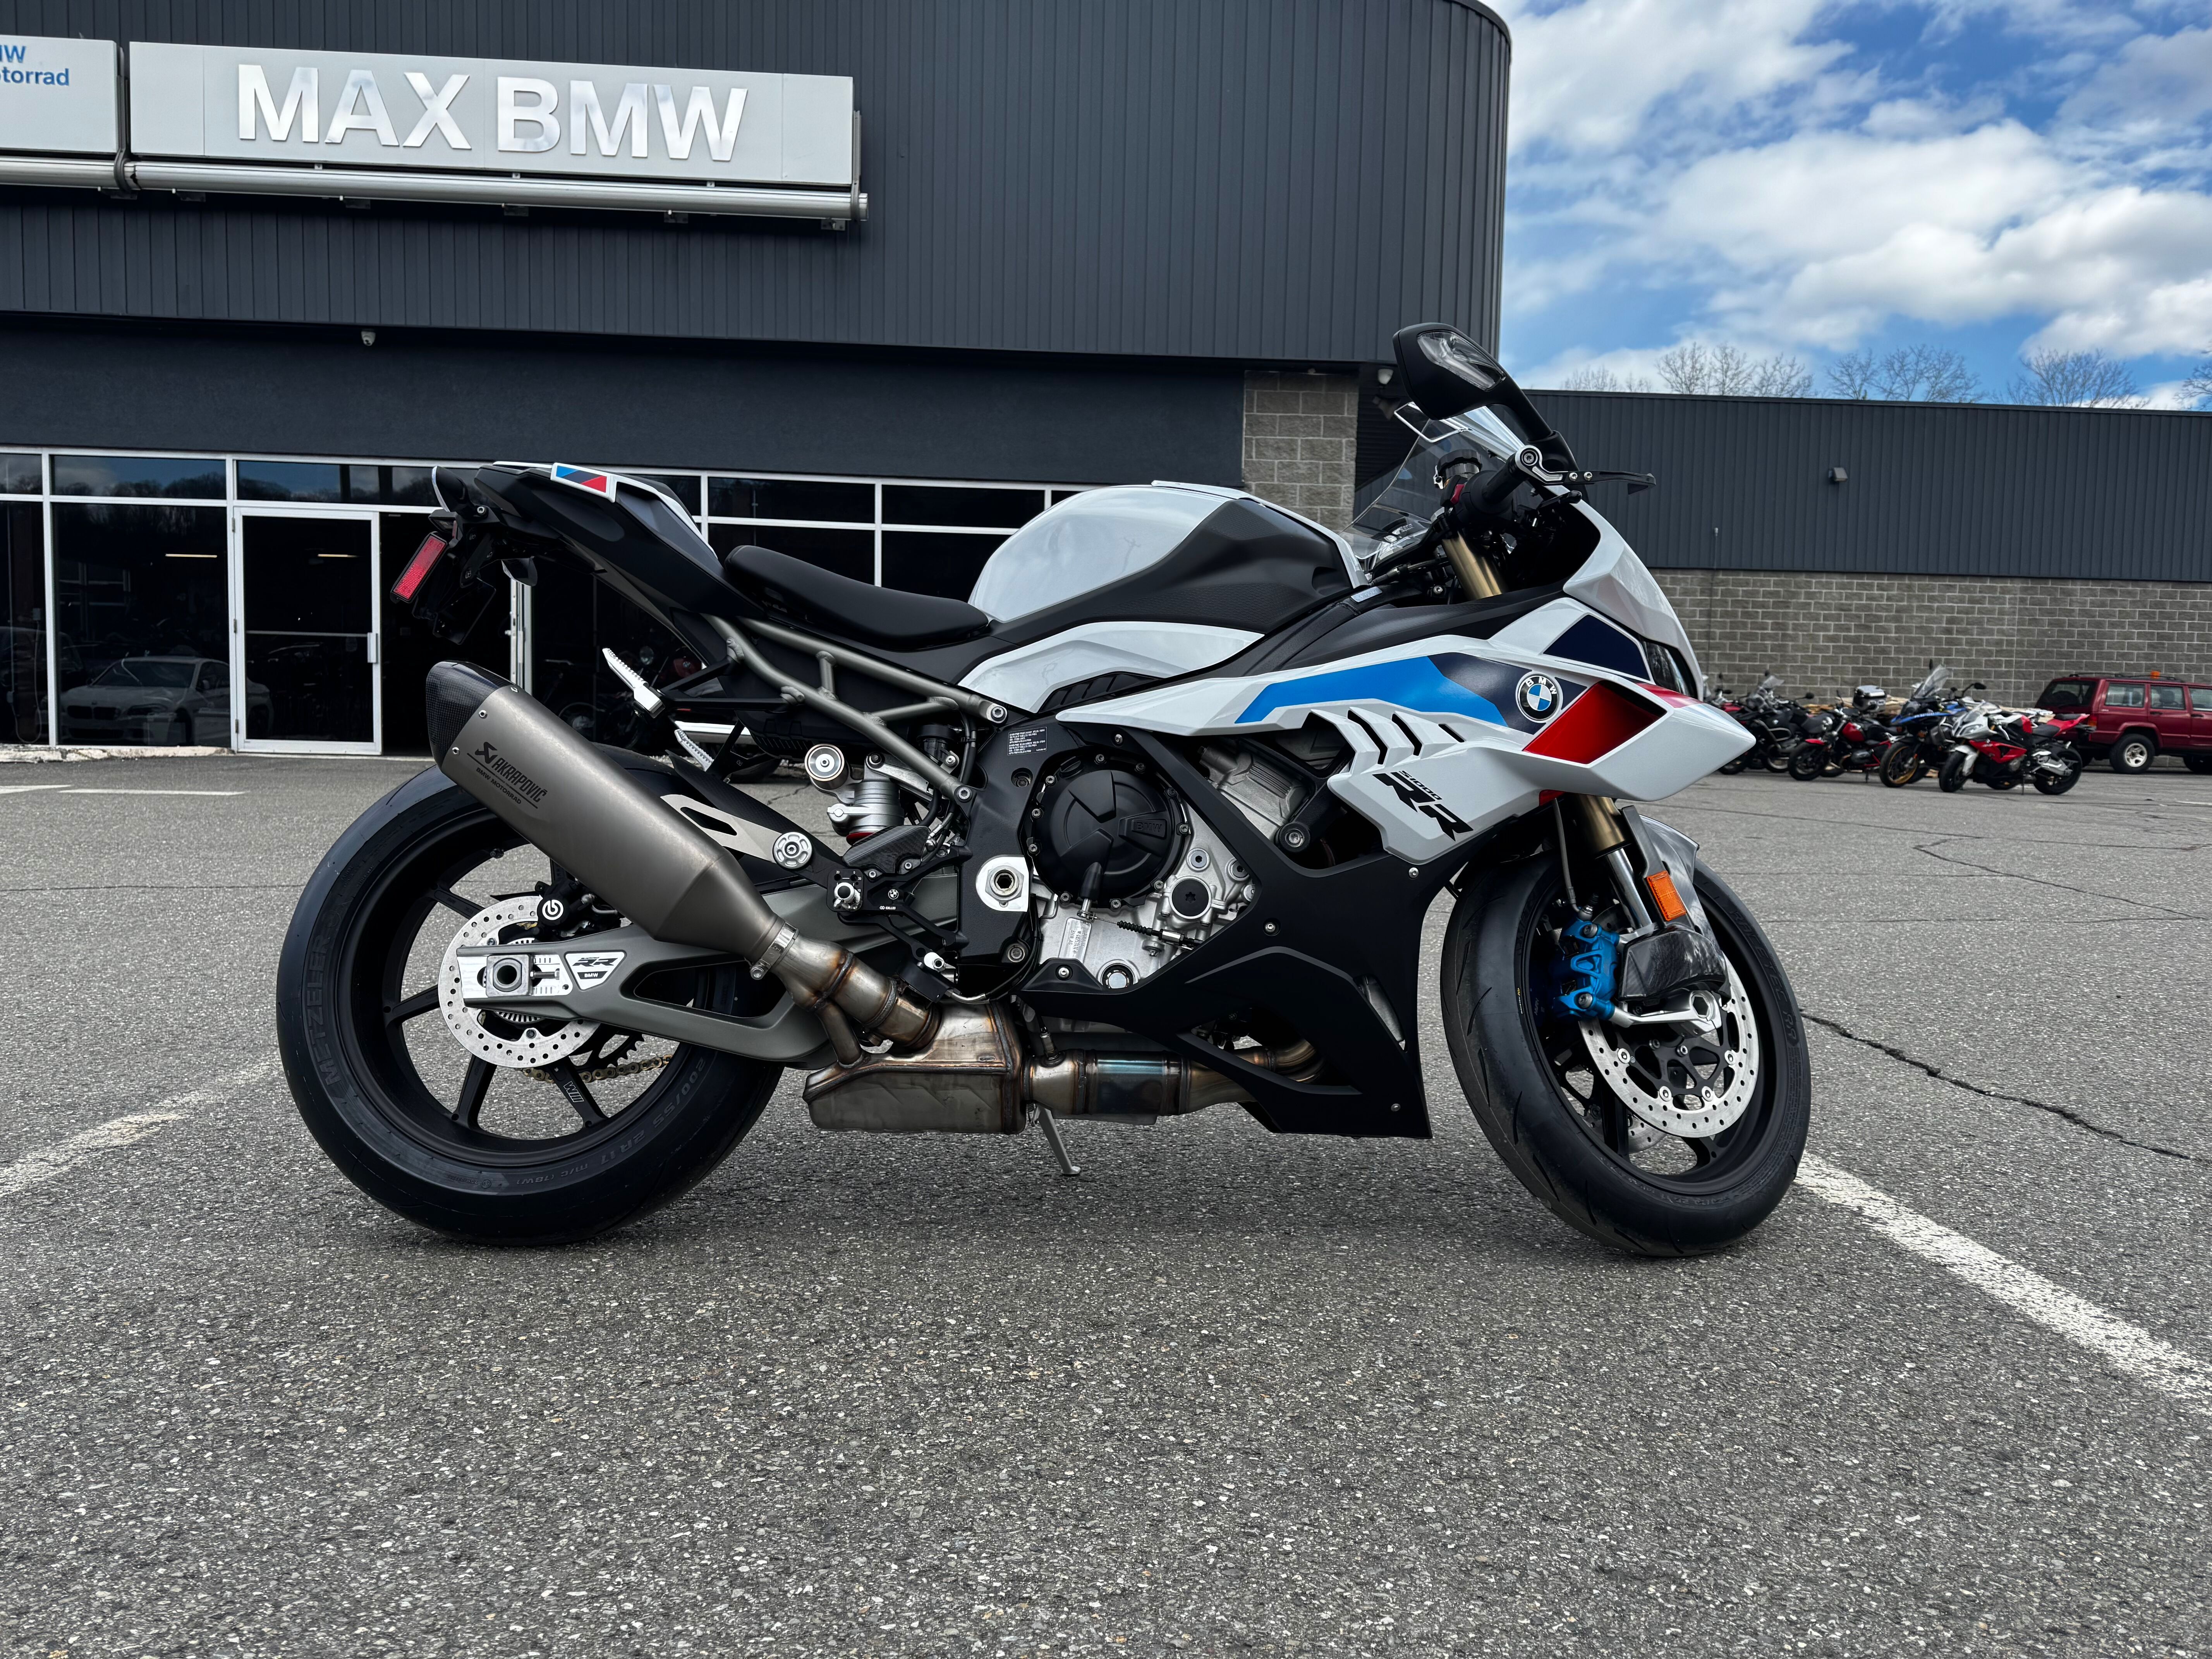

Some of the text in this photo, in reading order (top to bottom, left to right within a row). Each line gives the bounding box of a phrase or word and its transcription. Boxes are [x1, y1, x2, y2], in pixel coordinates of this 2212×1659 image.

[0, 45, 26, 63] W
[0, 66, 69, 86] torrad
[239, 64, 748, 161] MAX BMW
[1526, 677, 1557, 694] BMW
[476, 767, 491, 780] BMW
[491, 778, 522, 804] MOTORRAD
[1398, 770, 1443, 800] S1000
[1372, 771, 1474, 842] RR
[1137, 822, 1162, 833] BMW
[572, 958, 618, 967] RR
[1730, 910, 1788, 1002] RACETEC
[307, 935, 341, 1085] METZELER
[653, 1057, 706, 1128] 200/55
